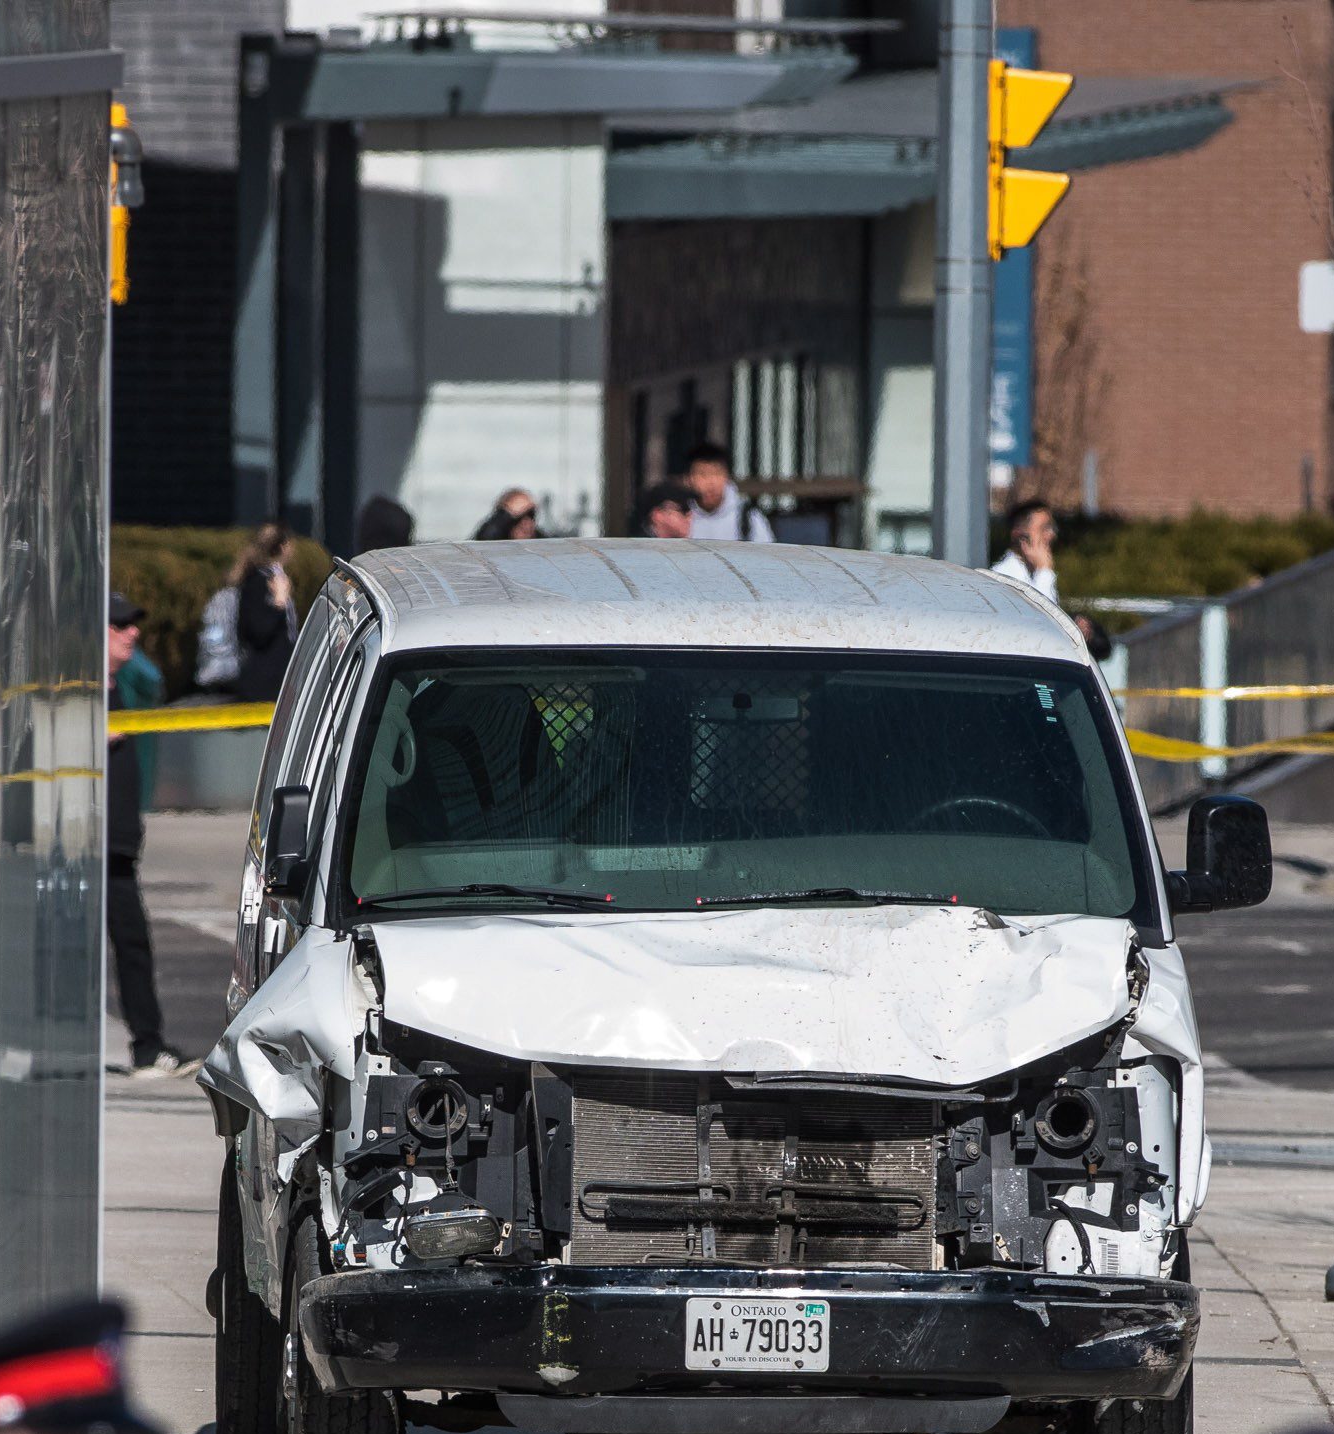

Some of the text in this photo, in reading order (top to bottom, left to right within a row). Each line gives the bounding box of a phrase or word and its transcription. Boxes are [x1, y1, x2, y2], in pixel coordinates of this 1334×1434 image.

[731, 1304, 787, 1317] ONTARIO
[692, 1318, 824, 1353] AH 79033
